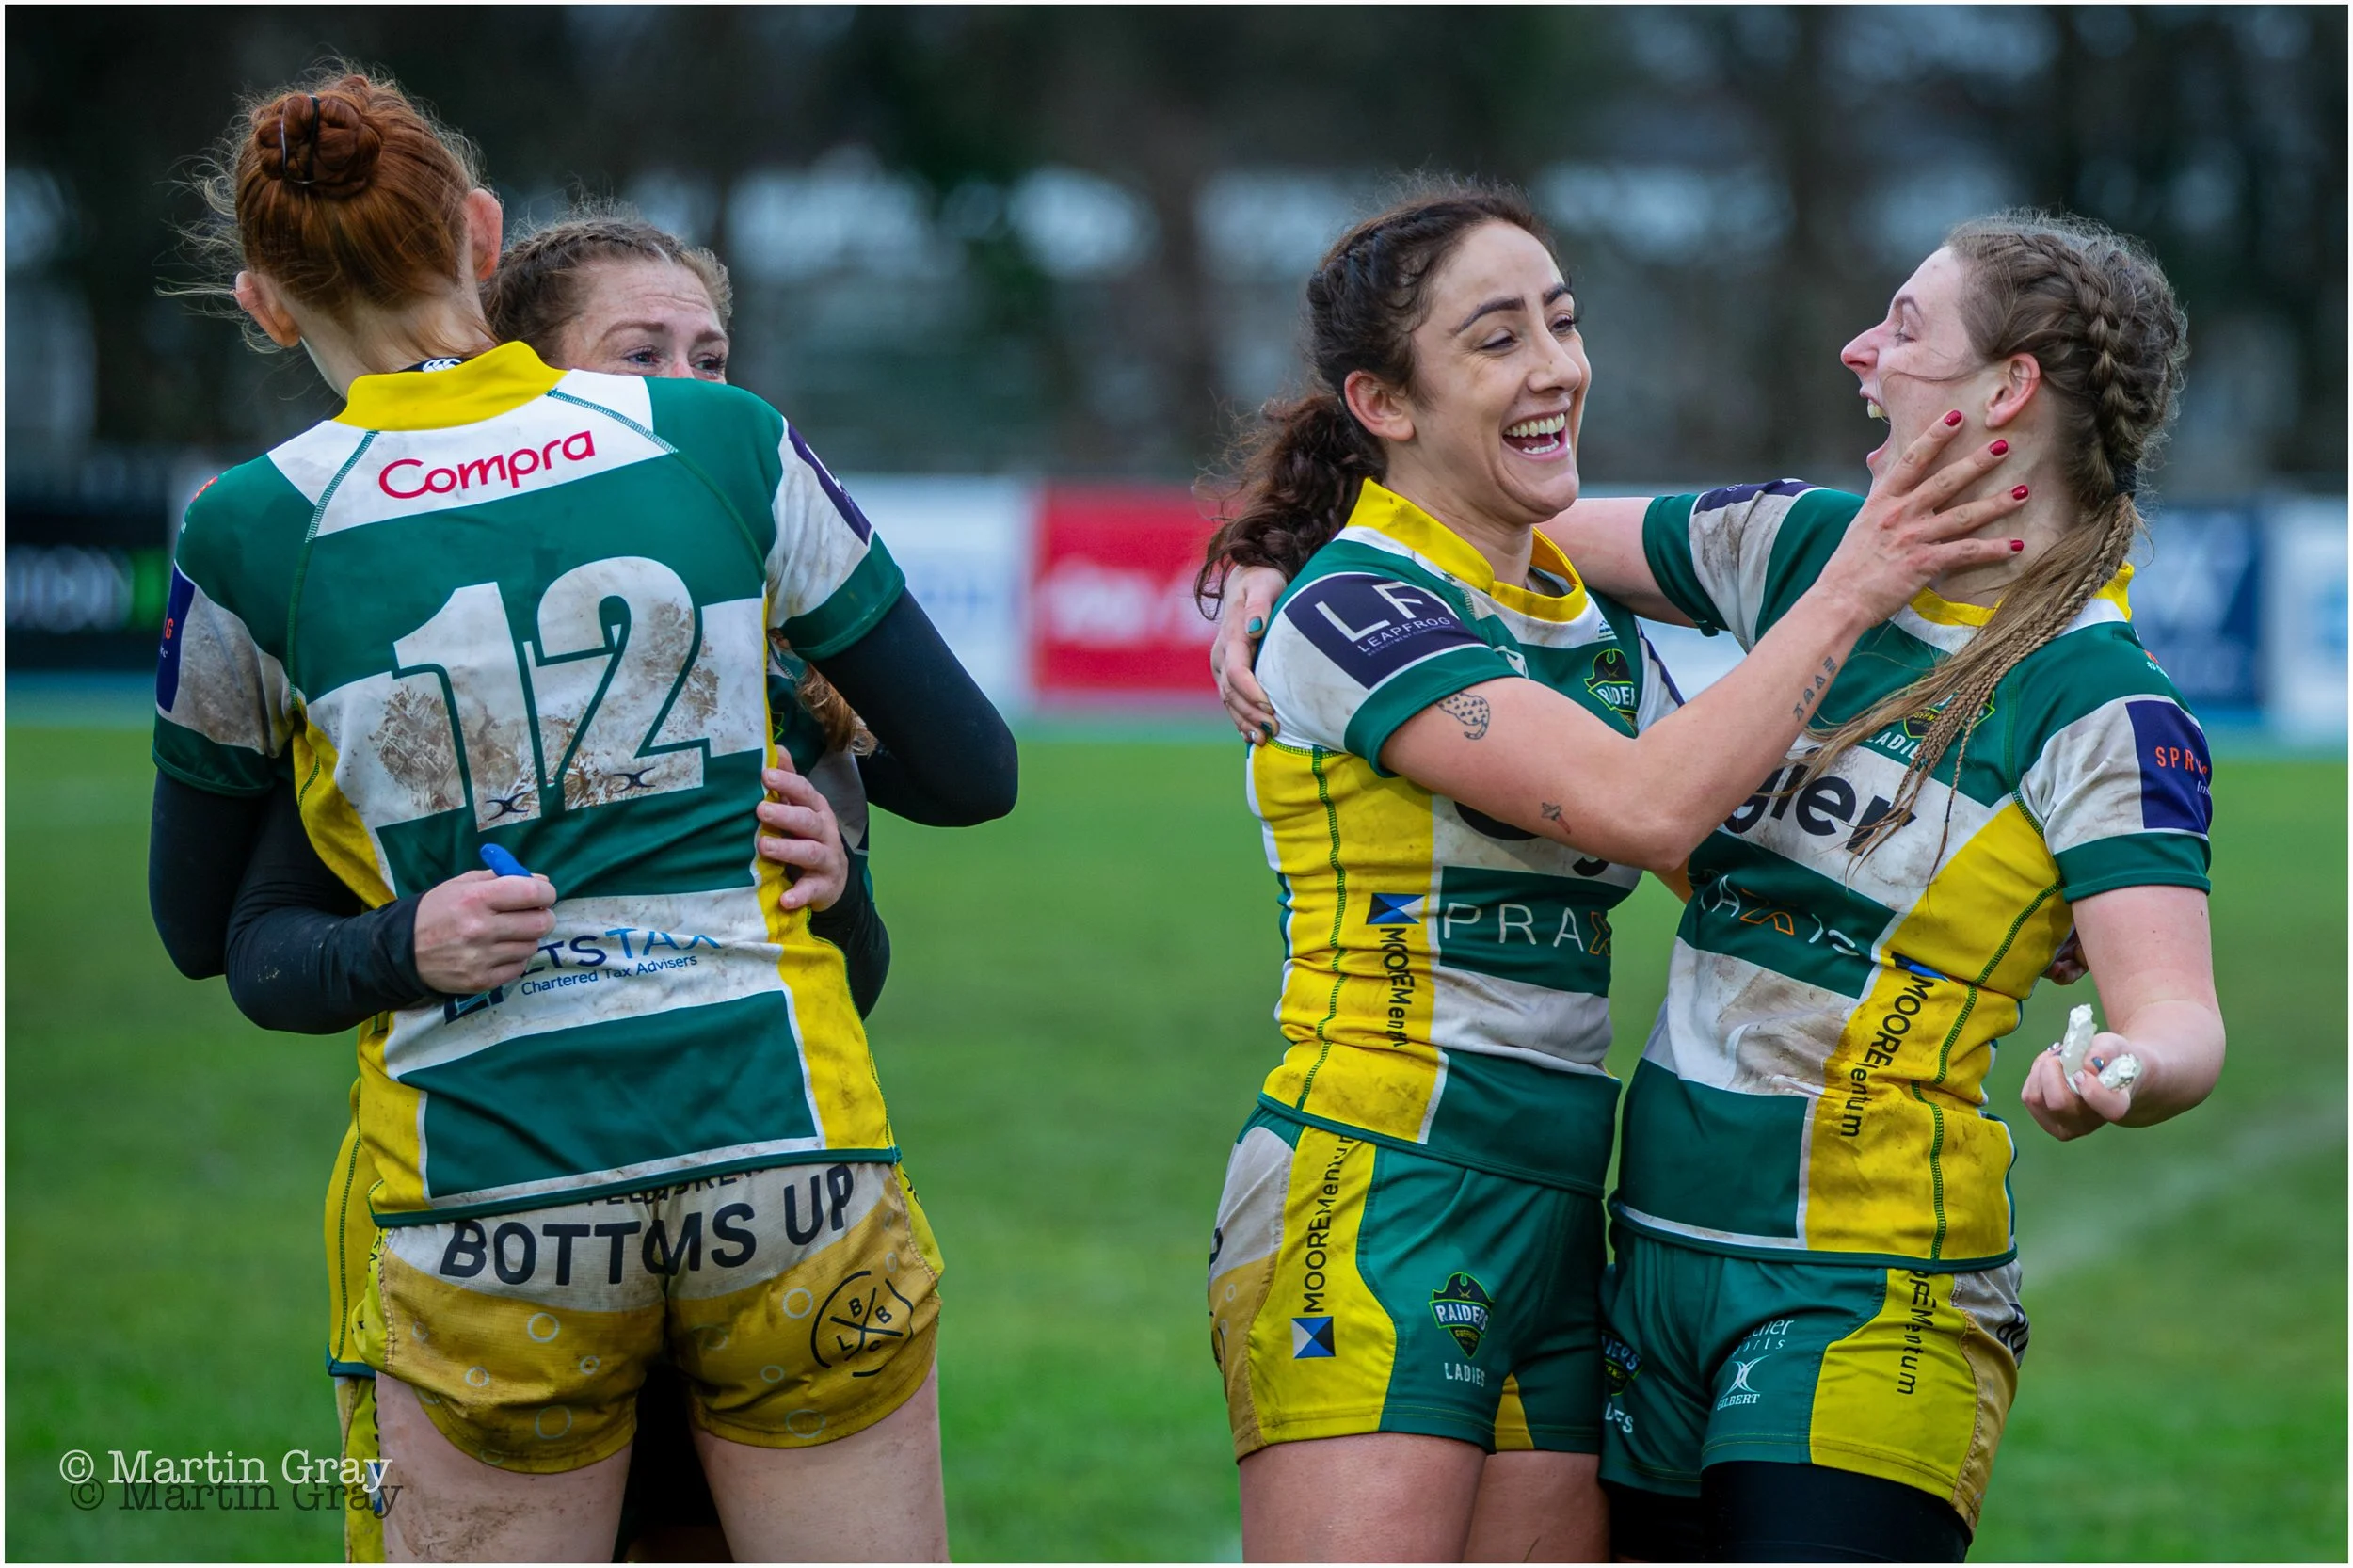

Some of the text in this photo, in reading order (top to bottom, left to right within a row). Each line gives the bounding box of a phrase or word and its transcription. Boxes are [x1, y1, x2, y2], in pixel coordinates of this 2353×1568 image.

[378, 430, 596, 499] Compra
[1314, 581, 1424, 644] LF
[1357, 616, 1451, 653] LEAPFROG
[392, 555, 704, 832] 12
[520, 953, 698, 996] Chartered Tax Advisers
[782, 1163, 854, 1246] UP
[1435, 1304, 1489, 1331] RAIDERS
[1444, 1362, 1485, 1387] LADIES
[1716, 1393, 1761, 1411] GILBERT
